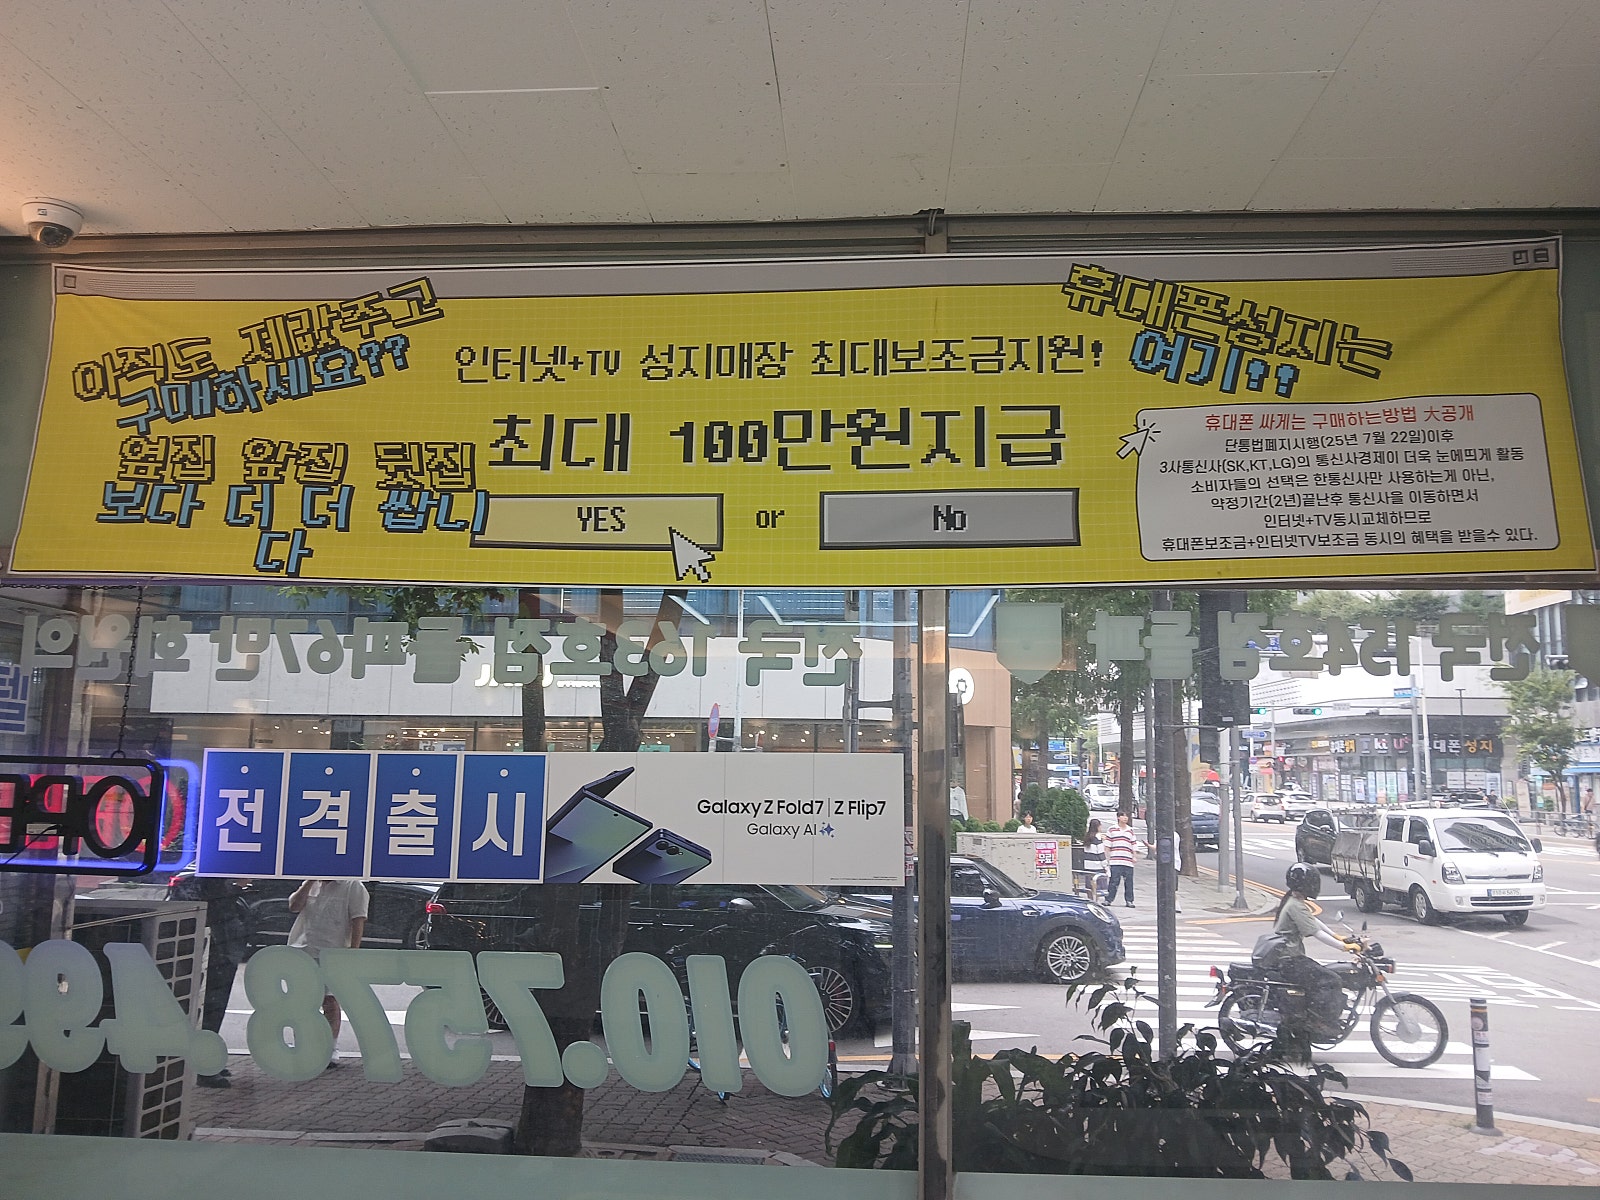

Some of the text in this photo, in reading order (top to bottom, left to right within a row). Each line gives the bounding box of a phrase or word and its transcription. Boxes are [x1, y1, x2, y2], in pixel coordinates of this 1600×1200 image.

[1061, 262, 1394, 380] 휴대폰성지는
[72, 276, 444, 401] 아직도 제값주고
[455, 334, 1104, 385] 인터넷+TV 성지매장 최대보조금지원!
[1129, 329, 1300, 398] 여기!!
[117, 334, 410, 435] 구매하세요??
[1205, 404, 1475, 432] 휴대폰 싸게는 구매하는방법 大공개
[488, 404, 1067, 472] 최대 100만원지급
[1362, 431, 1386, 445] 7월
[1390, 429, 1455, 444] 22일)이후
[118, 434, 477, 493] 옆집 앞집 뒷집
[1159, 455, 1311, 474] 3사통신사(SK,KT,LG)의
[1404, 449, 1432, 464] 더욱
[1496, 446, 1525, 461] 활동
[1191, 468, 1495, 494] 소비자들의 선택은 한통신사만 사용하는게 아닌,
[96, 481, 490, 537] 보다 더 더 쌉니
[1211, 488, 1480, 510] 약정기간(2년)끝난후 통신사을 이동하면서
[576, 506, 626, 532] YES
[755, 508, 786, 531] or
[932, 505, 968, 532] No
[1263, 510, 1432, 529] 인터넷+TV동시교체하므로
[253, 529, 314, 577] 다
[1161, 527, 1539, 552] 휴대폰보조금+인터넷TV보조금 동시의 혜택을 받을수 있다.
[1464, 739, 1494, 753] 성지
[697, 799, 887, 820] Galaxy Z Fold7 Z Flip7
[746, 823, 818, 839] Galaxy AI
